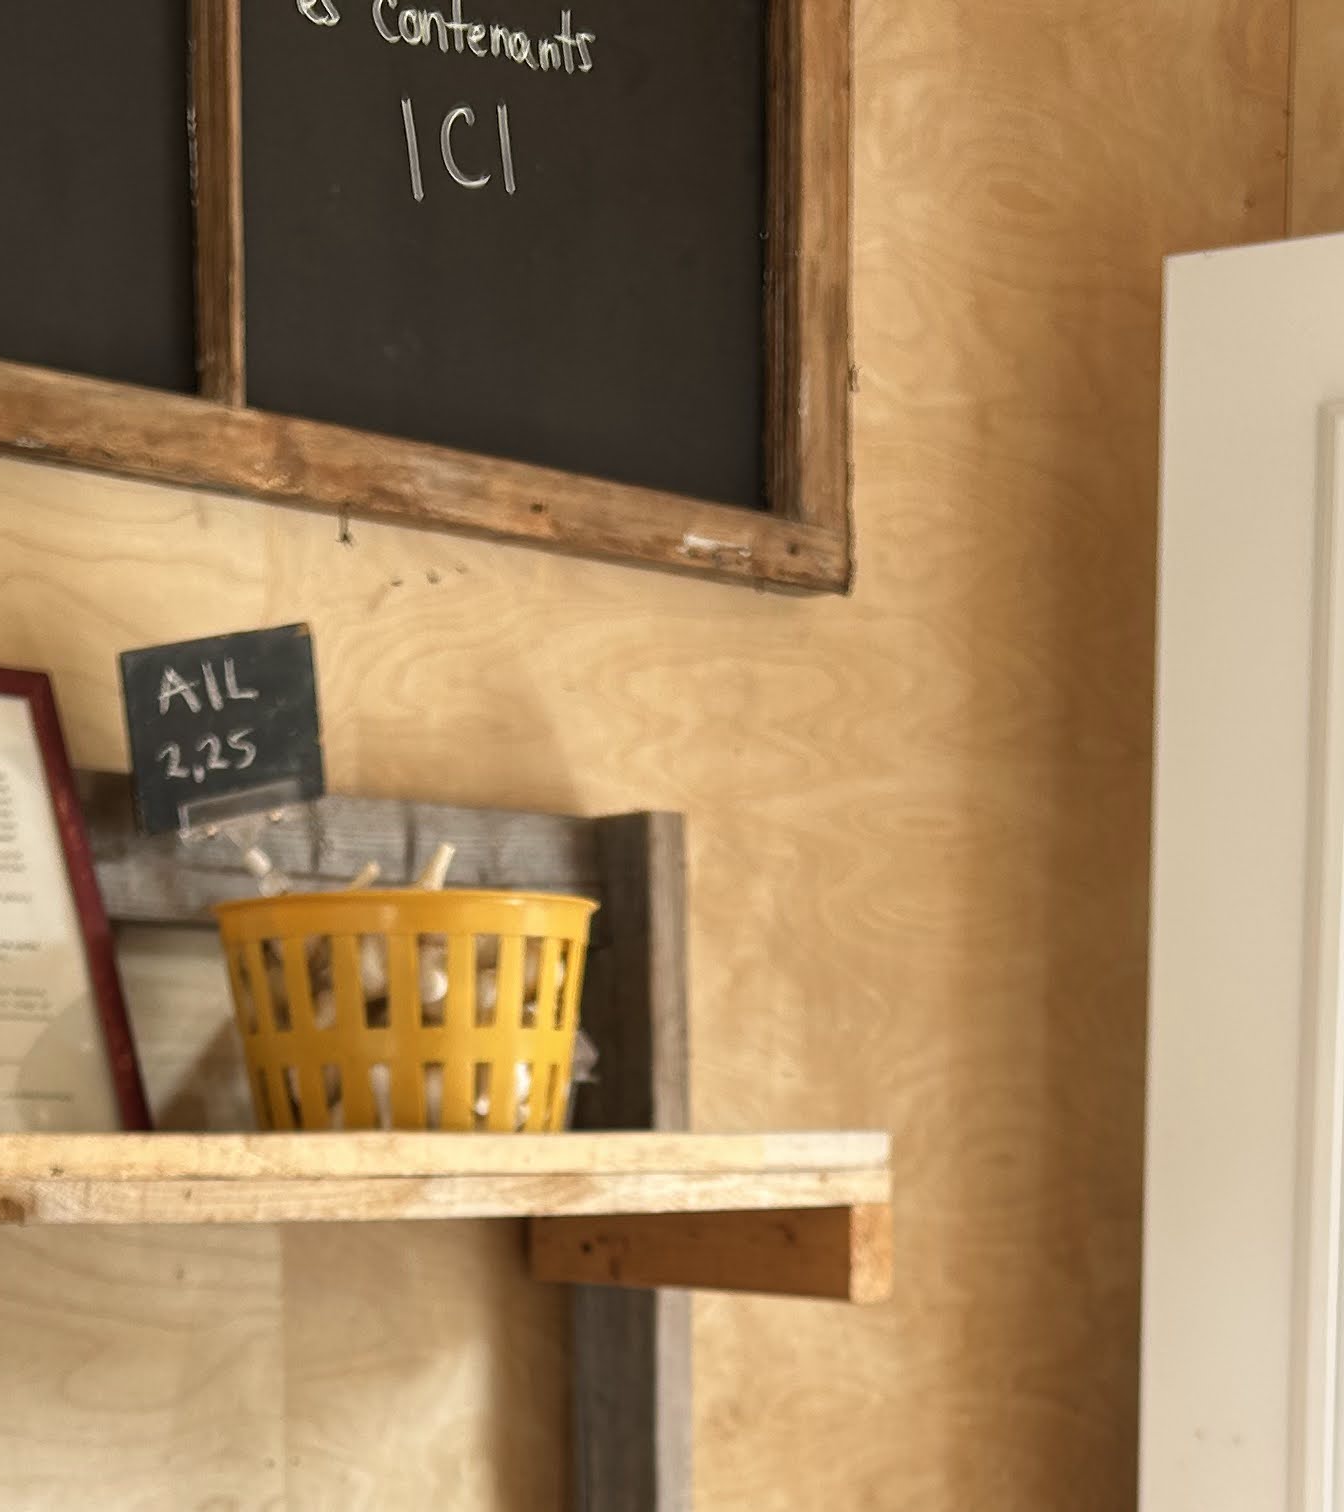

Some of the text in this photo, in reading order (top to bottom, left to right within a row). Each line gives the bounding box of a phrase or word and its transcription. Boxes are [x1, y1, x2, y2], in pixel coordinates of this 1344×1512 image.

[372, 0, 597, 74] Contenants
[400, 97, 516, 202] ICI
[157, 657, 260, 716] AIL
